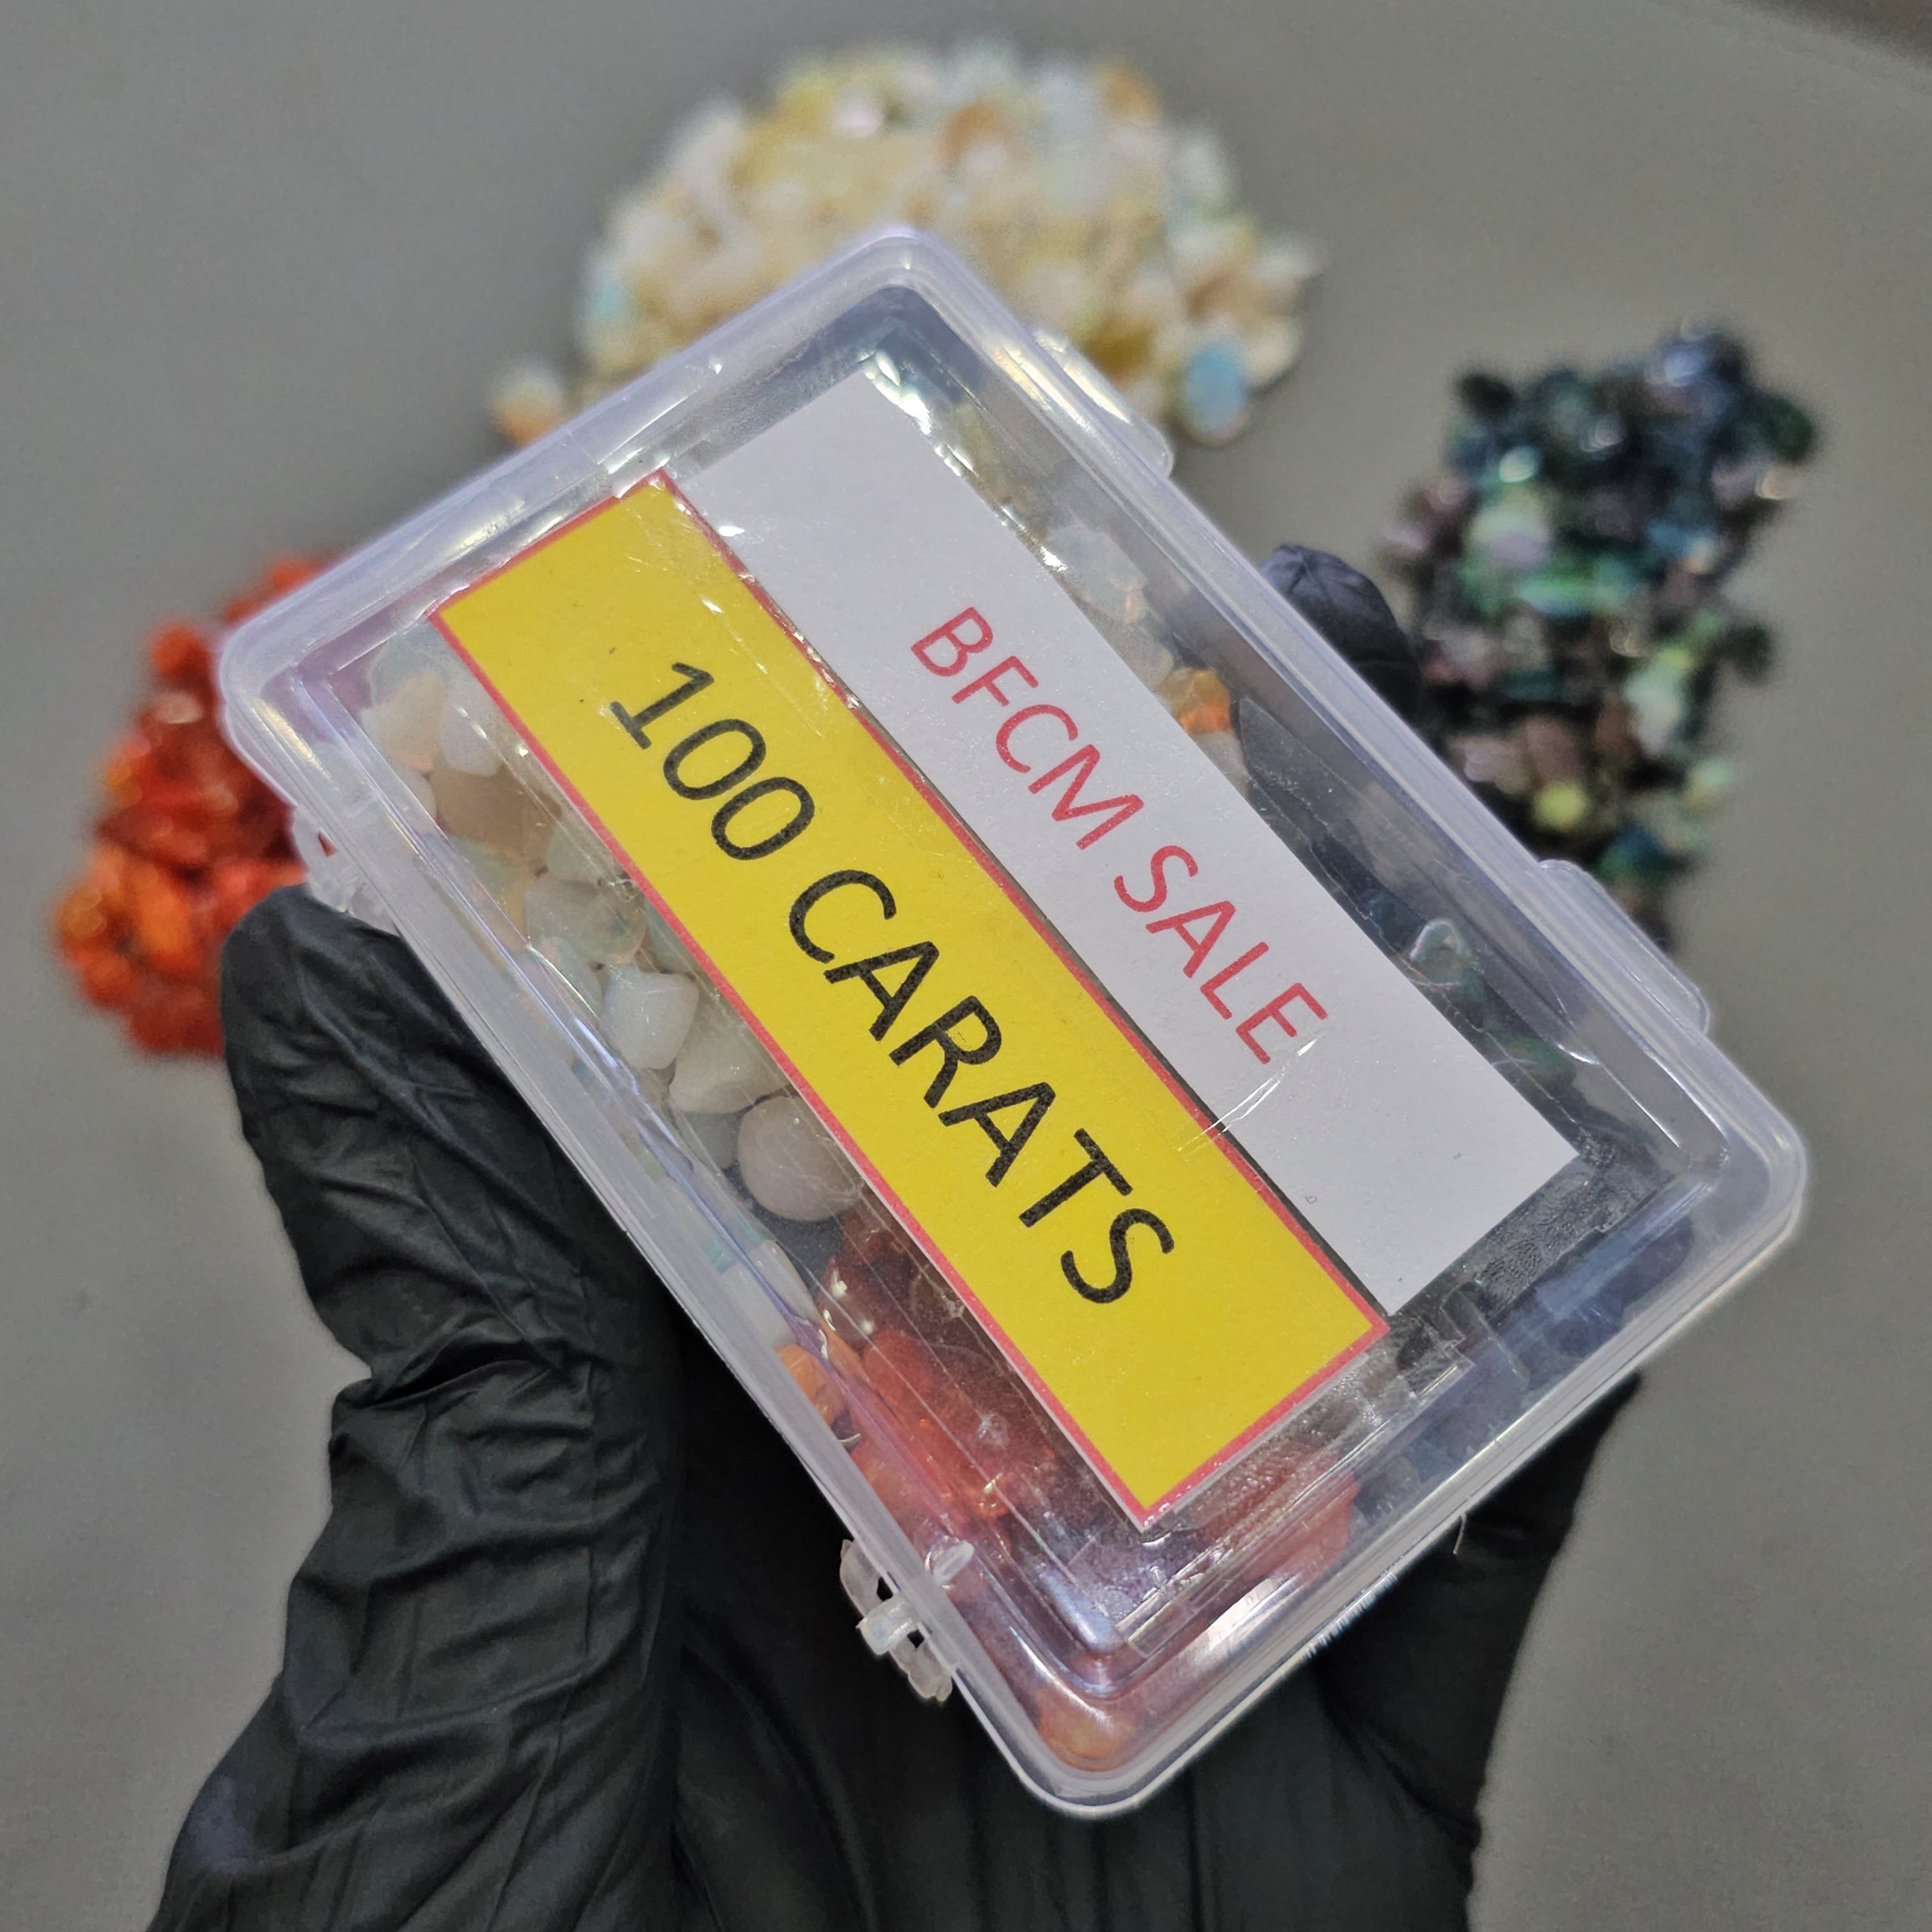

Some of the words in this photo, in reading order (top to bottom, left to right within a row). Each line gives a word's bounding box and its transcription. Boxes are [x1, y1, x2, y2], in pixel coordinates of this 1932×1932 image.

[610, 661, 816, 860] 100
[788, 869, 1175, 1304] CARATS
[911, 606, 1144, 850] BFCM
[1113, 845, 1328, 1065] SALE
